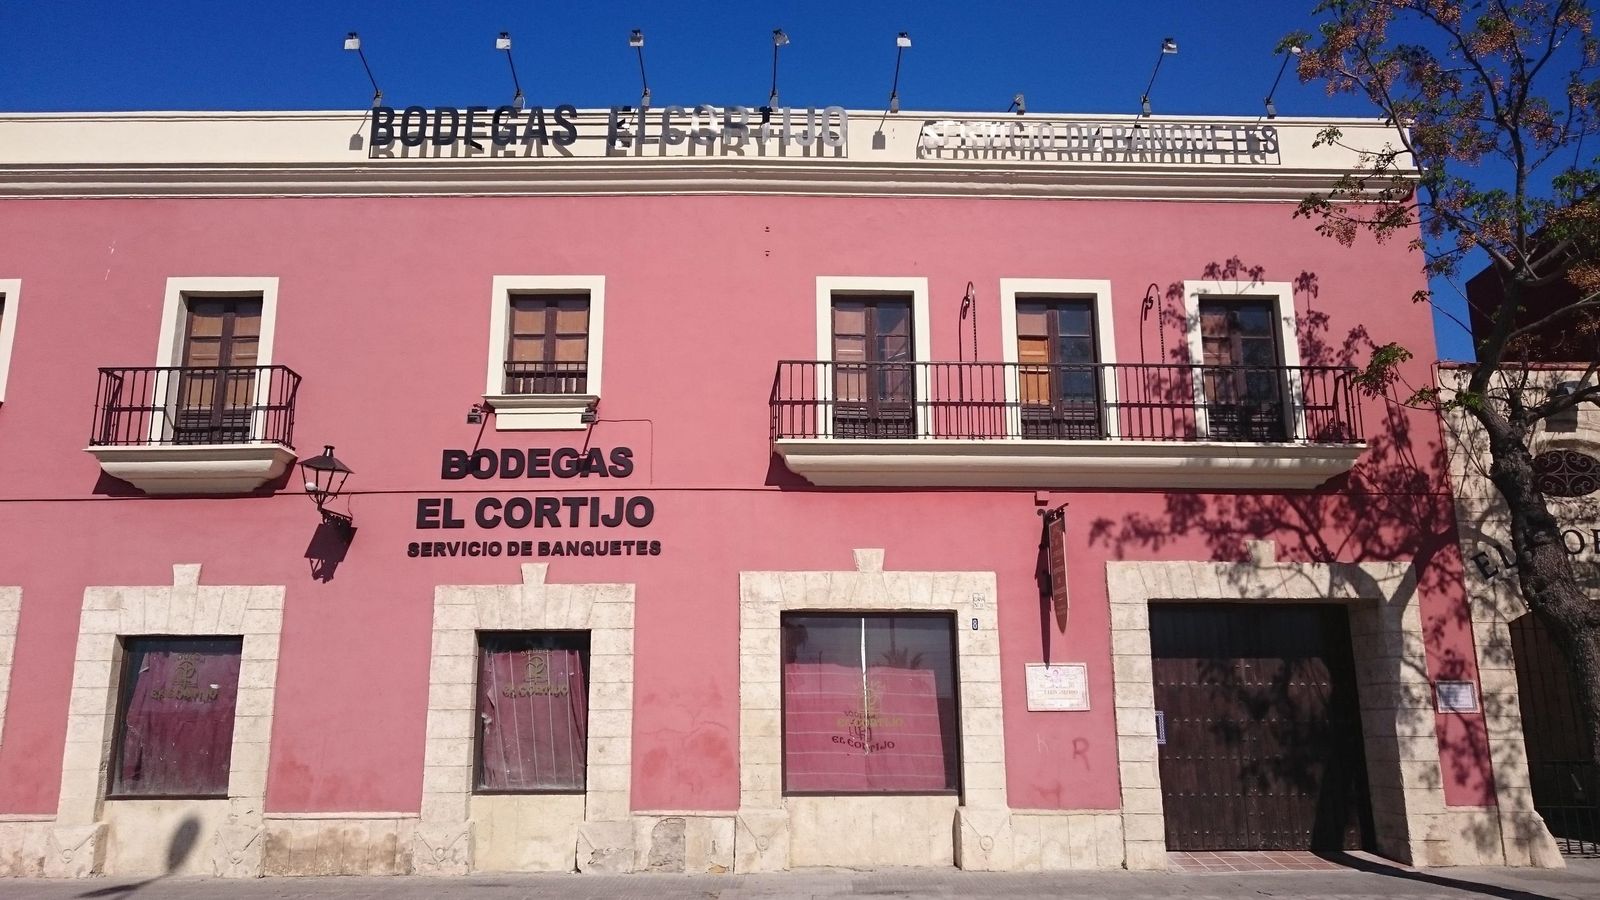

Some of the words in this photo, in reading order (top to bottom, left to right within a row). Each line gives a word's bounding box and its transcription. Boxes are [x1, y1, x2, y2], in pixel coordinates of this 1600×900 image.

[371, 105, 578, 147] BODEGAS
[607, 106, 659, 148] EL
[662, 105, 848, 147] CORTIJO
[441, 447, 634, 480] BODEGAS
[416, 498, 465, 530] EL
[475, 496, 655, 529] CORTIJO
[407, 541, 502, 557] SERVICIO
[507, 541, 533, 557] DE
[538, 540, 661, 557] BANQUETES
